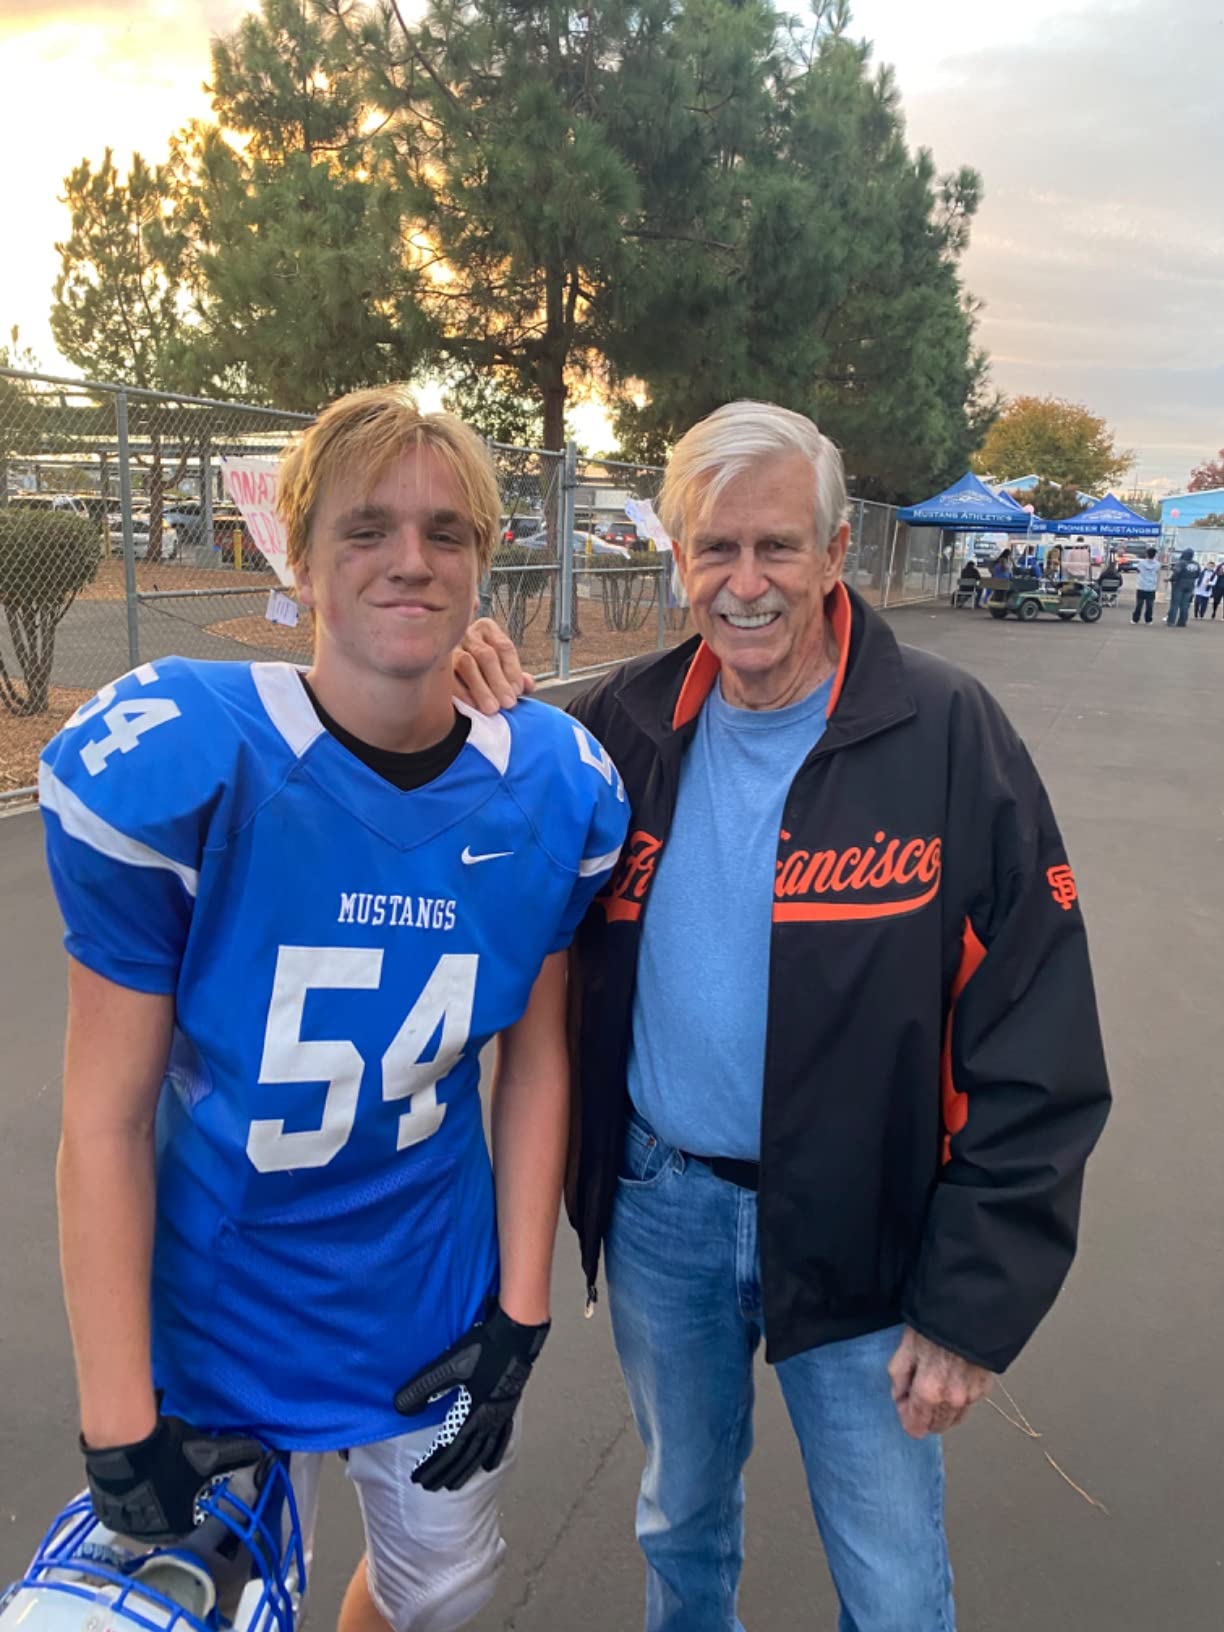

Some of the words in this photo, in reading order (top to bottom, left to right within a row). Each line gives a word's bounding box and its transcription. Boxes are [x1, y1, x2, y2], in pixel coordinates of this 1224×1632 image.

[912, 509, 958, 520] MUSTANG
[960, 511, 1012, 522] ATHLETICS
[1057, 524, 1098, 533] PIONEER
[1100, 525, 1151, 535] MUSTANGS
[337, 892, 457, 931] MUSTANGS
[246, 945, 480, 1173] 54
